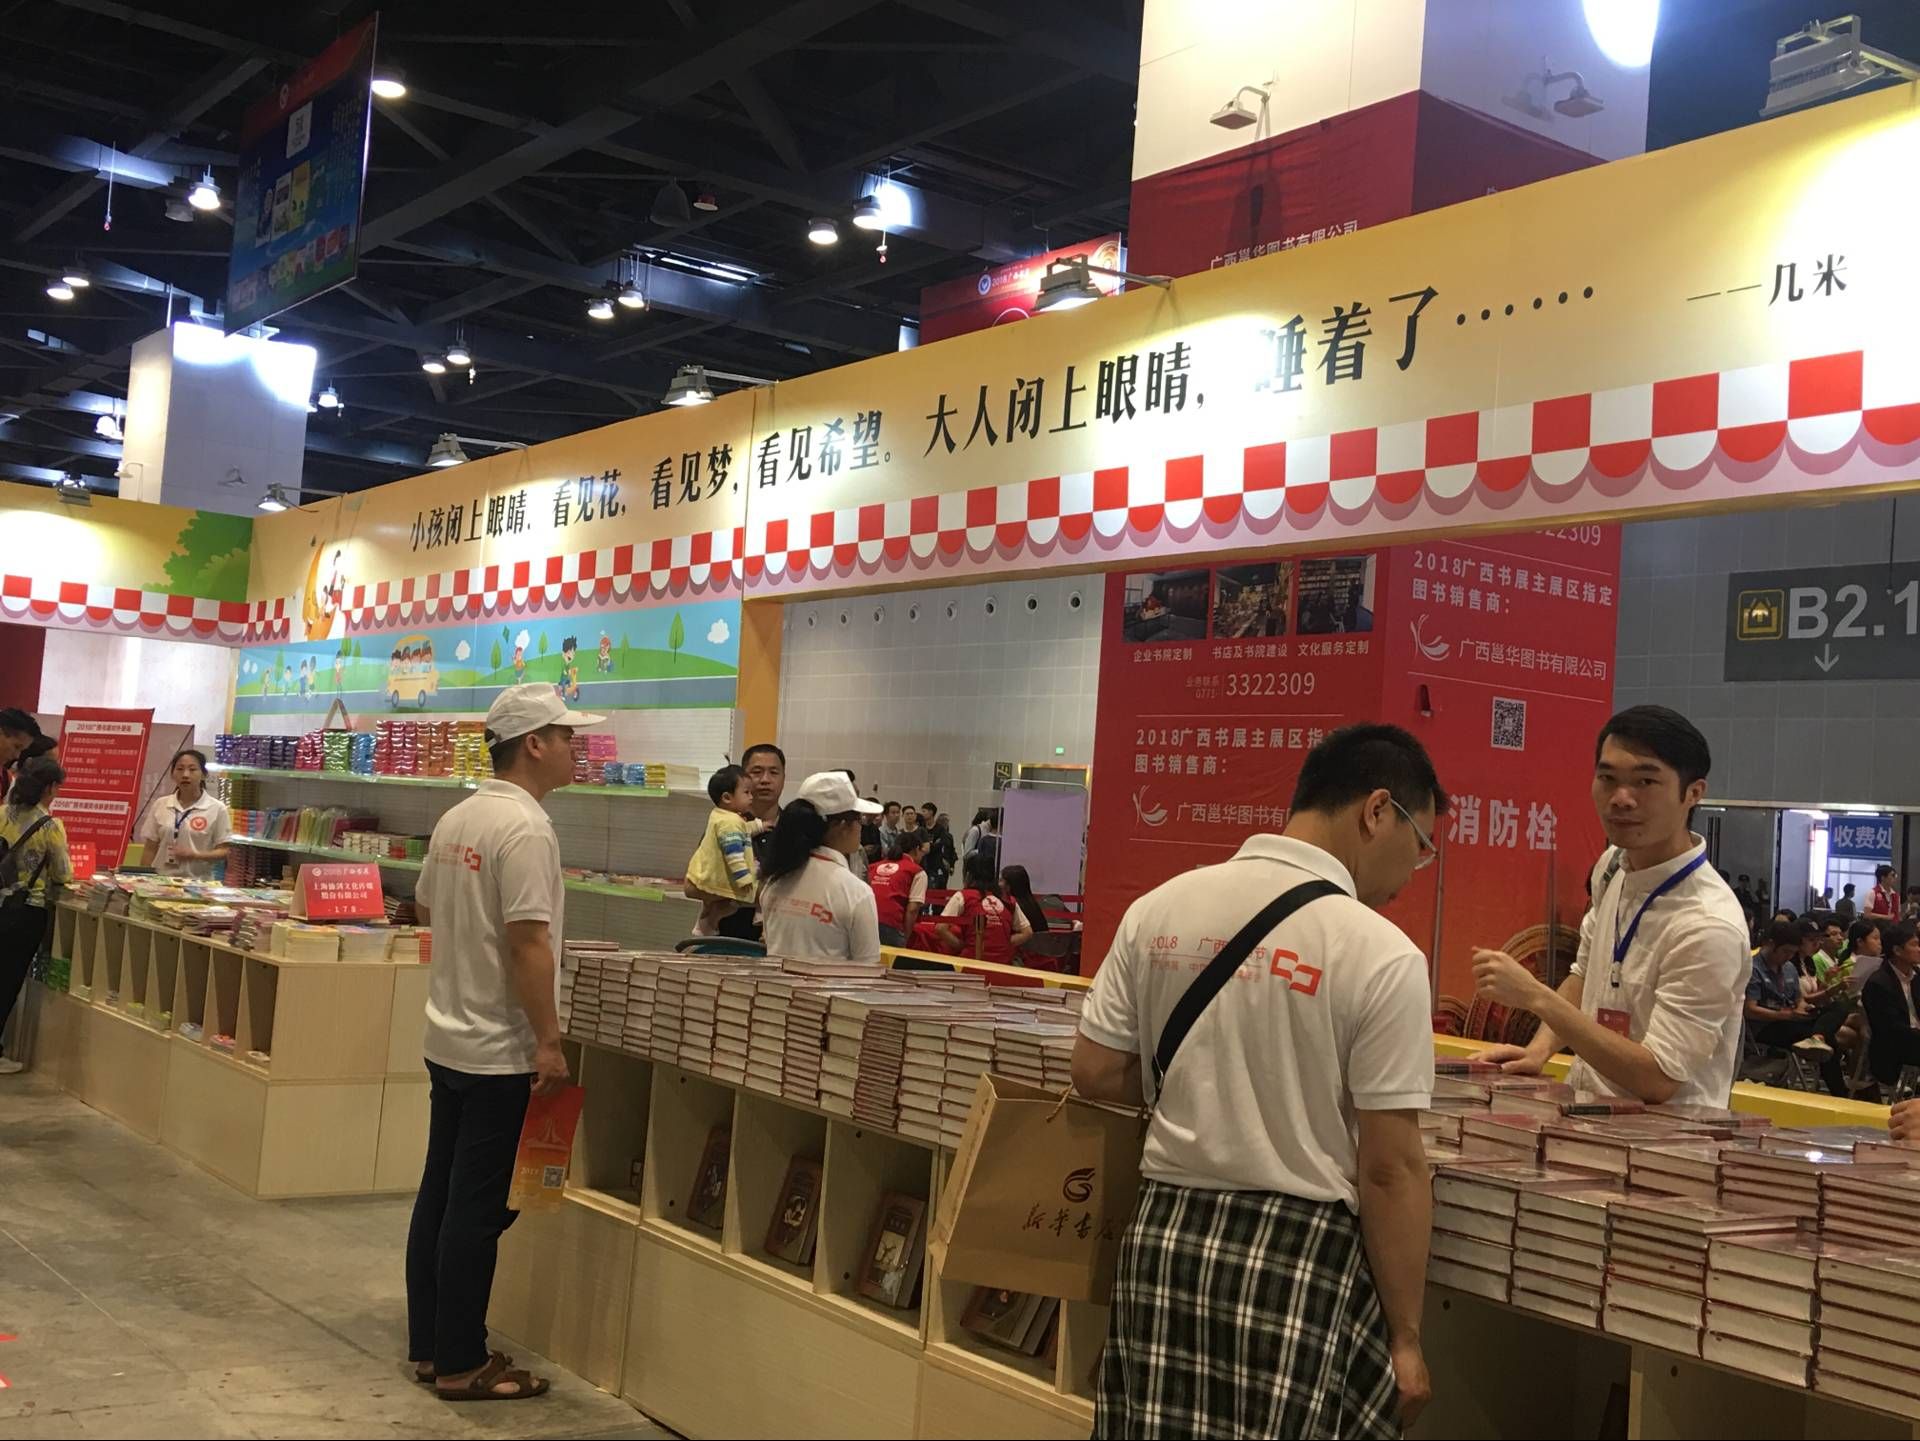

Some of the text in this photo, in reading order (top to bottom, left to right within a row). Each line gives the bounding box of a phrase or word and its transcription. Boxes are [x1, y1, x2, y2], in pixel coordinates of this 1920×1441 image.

[1414, 550, 1612, 606] 2018广西书展主展区指定
[1412, 578, 1511, 614] 图书销售商：
[1788, 579, 1919, 639] B2.1
[1133, 640, 1369, 663] 企业书院定制 书店及书院建设 文化服务定制
[1459, 637, 1607, 681] 广西邕华图书有限公司
[1226, 671, 1316, 697] 3322309
[1136, 727, 1328, 750] 2018广西书展主展区指
[1134, 754, 1228, 776] 图书销售商：
[1177, 802, 1291, 828] 广西邕华图书有
[1448, 795, 1558, 850] 消防栓
[1833, 824, 1892, 850] 收费处
